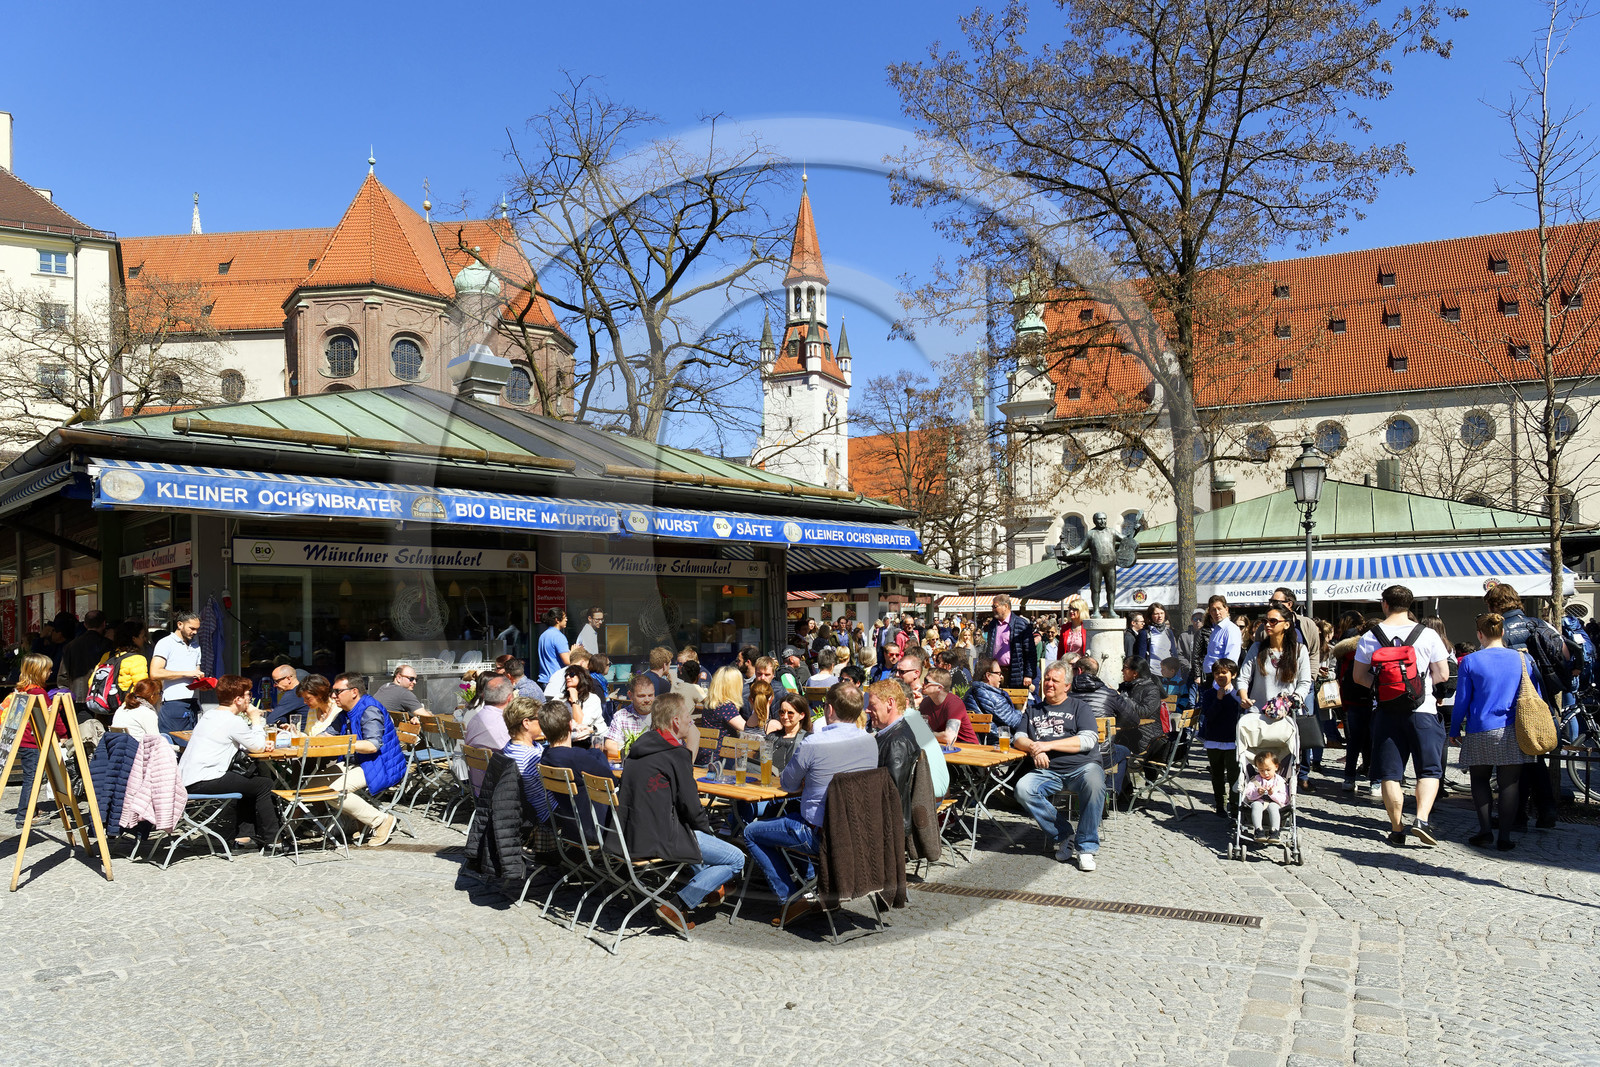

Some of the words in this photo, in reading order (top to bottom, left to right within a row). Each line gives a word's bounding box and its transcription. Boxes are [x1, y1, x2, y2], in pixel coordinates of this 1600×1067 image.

[157, 482, 248, 503] KLEINER
[455, 503, 486, 518] BIO
[489, 505, 537, 522] BIERE
[541, 511, 618, 527] NATURTRÜB
[652, 517, 699, 532] WURST
[736, 521, 773, 537] SÄFTE
[804, 529, 844, 542] KLEINER
[303, 544, 389, 563] Münchner
[394, 548, 483, 566] Schmankerl
[609, 556, 666, 573] Münchner
[671, 559, 732, 575] Schmankerl
[1226, 588, 1273, 597] MÜNCHENS
[1324, 581, 1387, 598] Gaststätte
